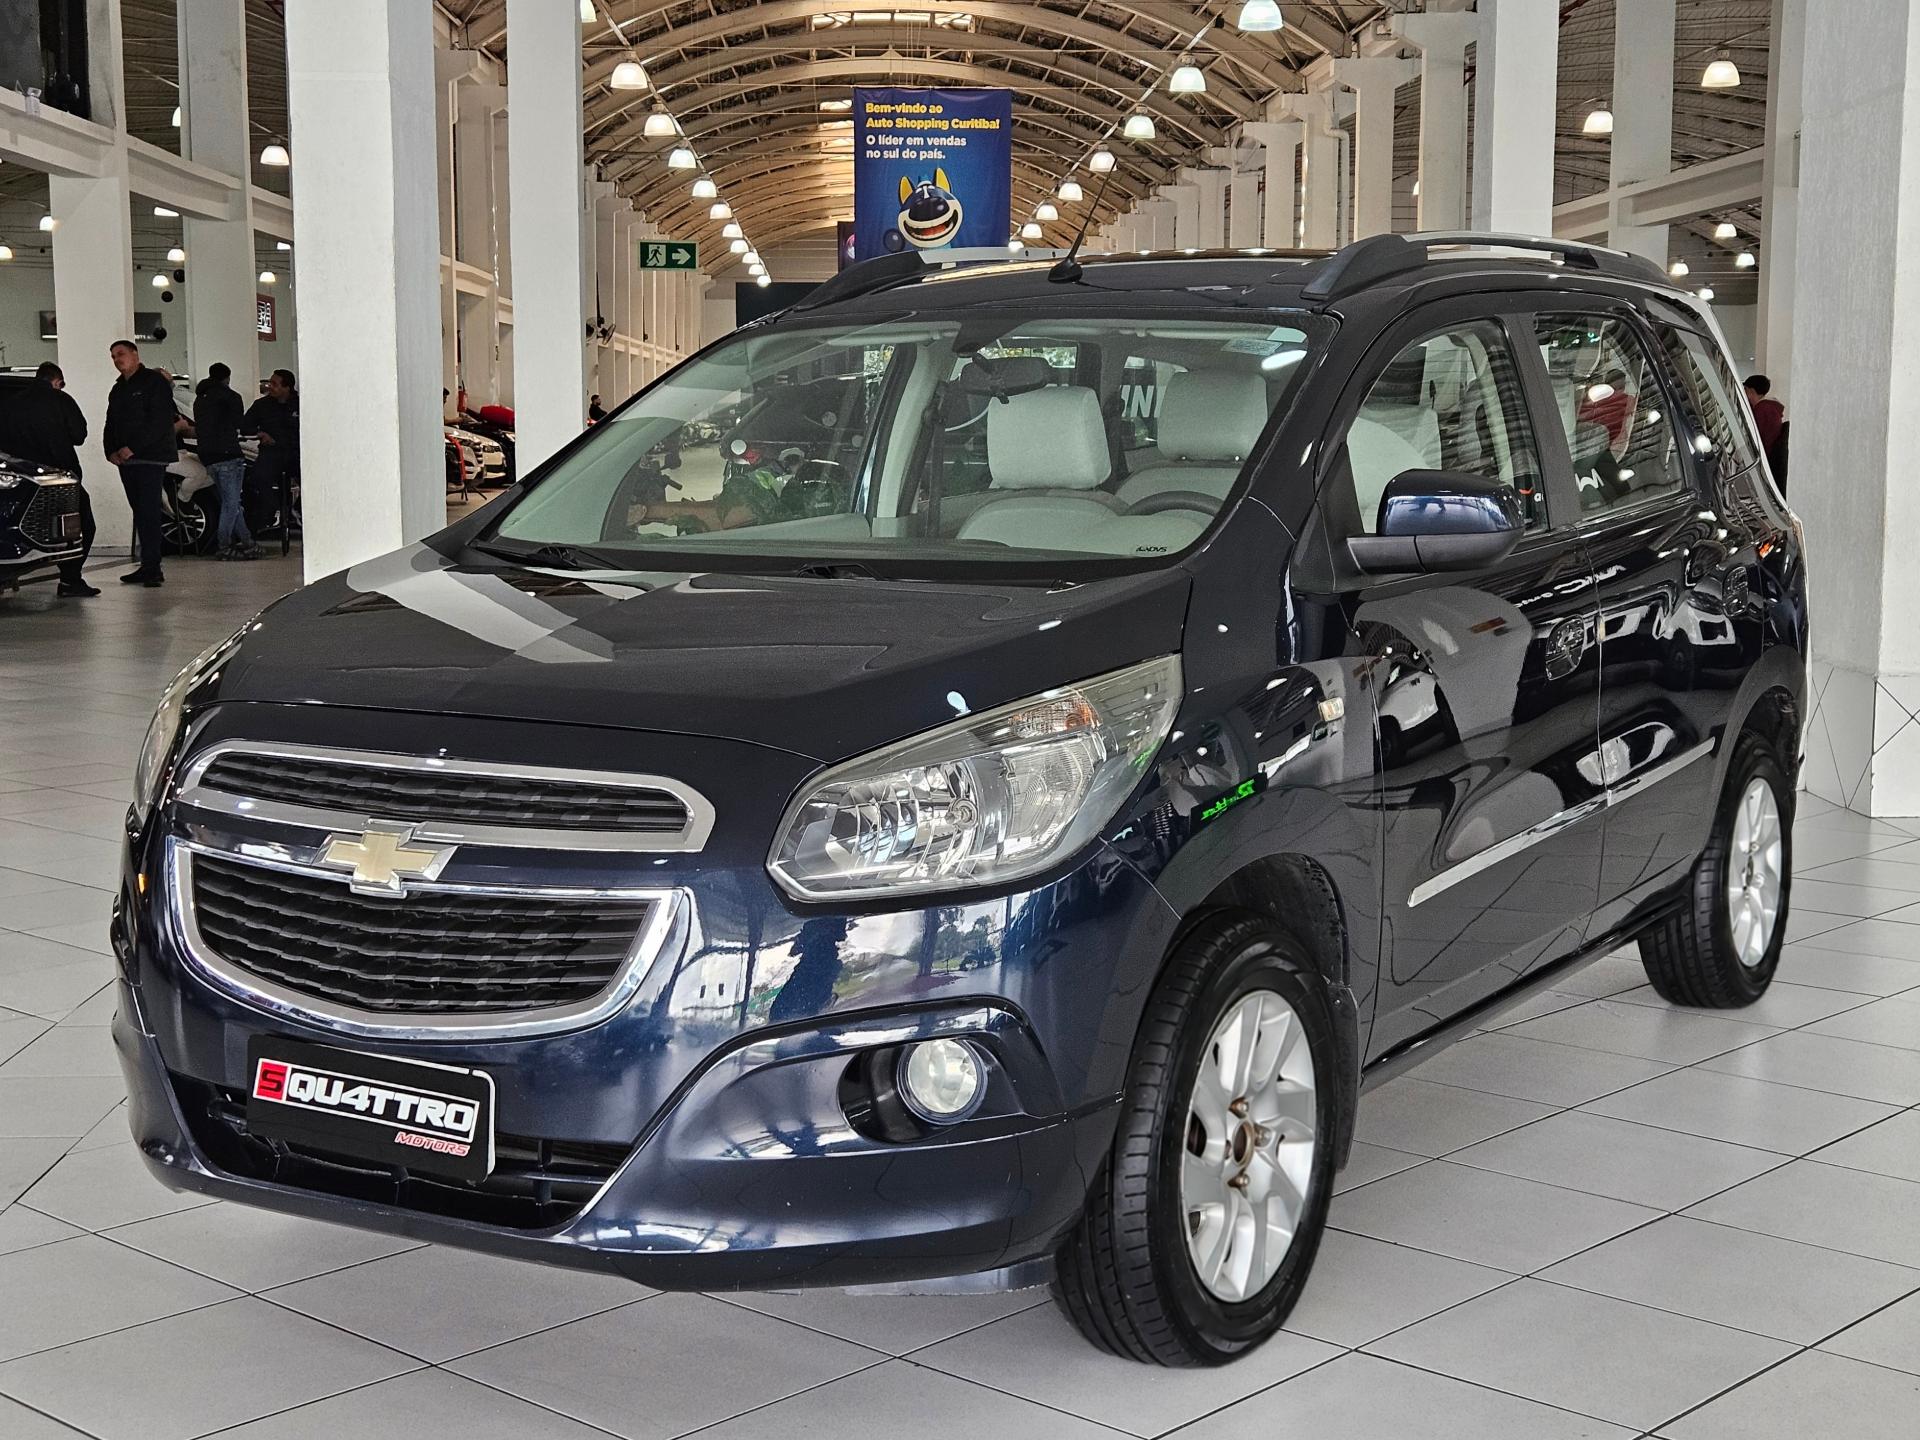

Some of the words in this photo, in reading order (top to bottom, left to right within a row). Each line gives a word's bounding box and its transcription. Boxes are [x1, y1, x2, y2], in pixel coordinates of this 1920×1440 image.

[865, 102, 927, 114] Bem-vindo
[928, 104, 944, 114] ao
[866, 117, 894, 128] Auto
[895, 118, 949, 130] Shopping
[951, 118, 1000, 129] Curitiba!
[866, 134, 876, 146] O
[878, 134, 904, 146] líder
[906, 136, 924, 146] em
[926, 135, 967, 147] vendas
[866, 149, 881, 159] no
[883, 148, 899, 159] sul
[901, 148, 918, 159] do
[919, 148, 946, 160] país.
[394, 1131, 470, 1157] MOTORS
